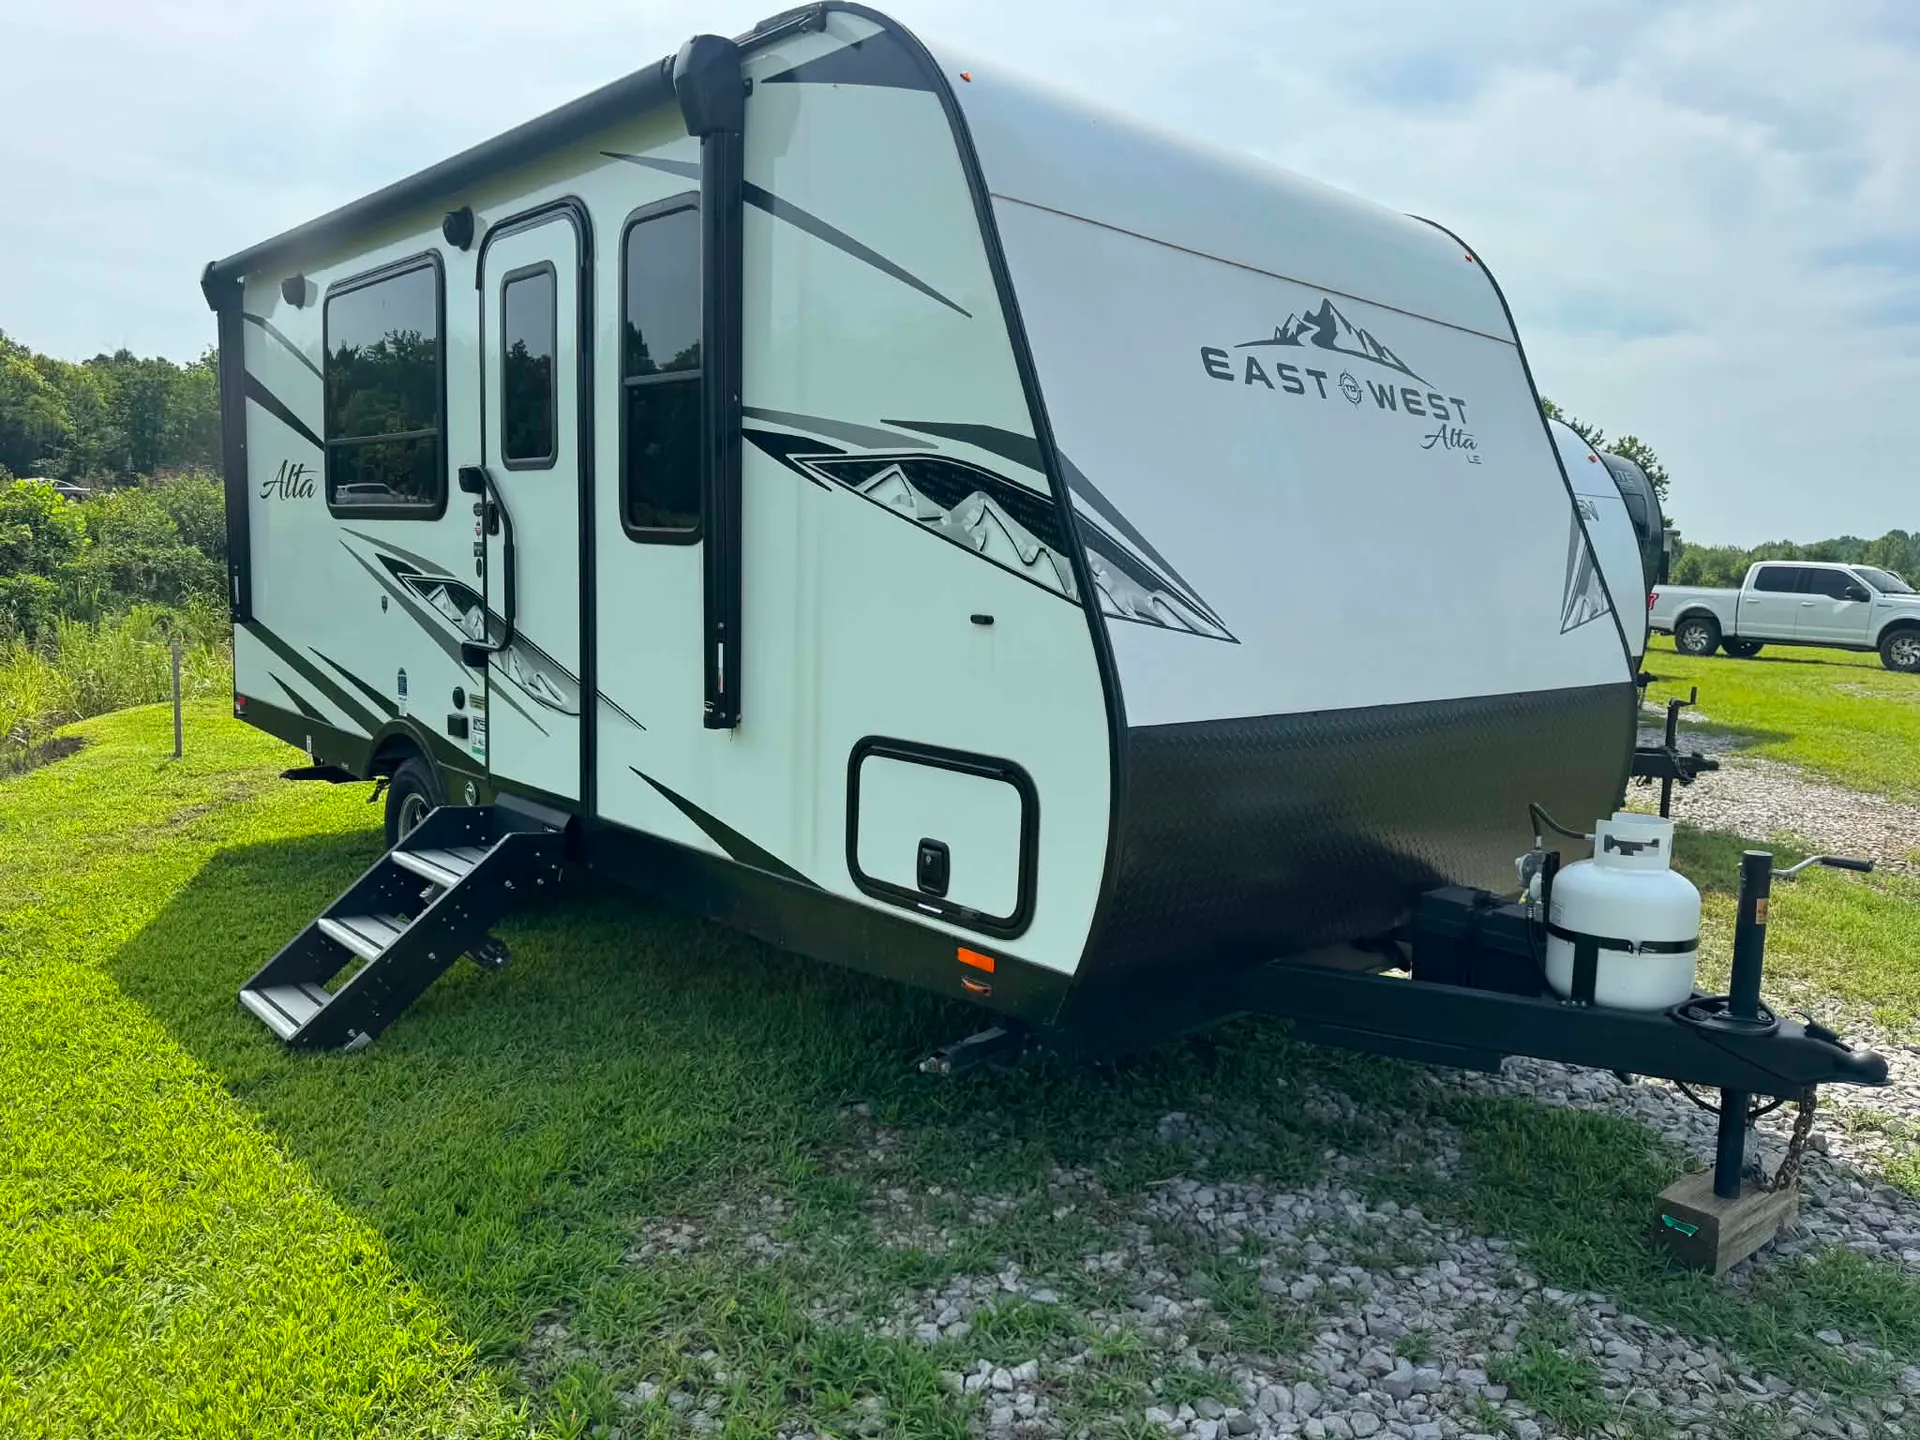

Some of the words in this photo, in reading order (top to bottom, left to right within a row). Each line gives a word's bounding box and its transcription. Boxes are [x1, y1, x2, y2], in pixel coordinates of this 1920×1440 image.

[1200, 346, 1328, 400] EAST
[1366, 380, 1468, 425] WEST
[1419, 423, 1478, 450] Alta
[1466, 455, 1482, 465] LE
[259, 459, 318, 501] Alta
